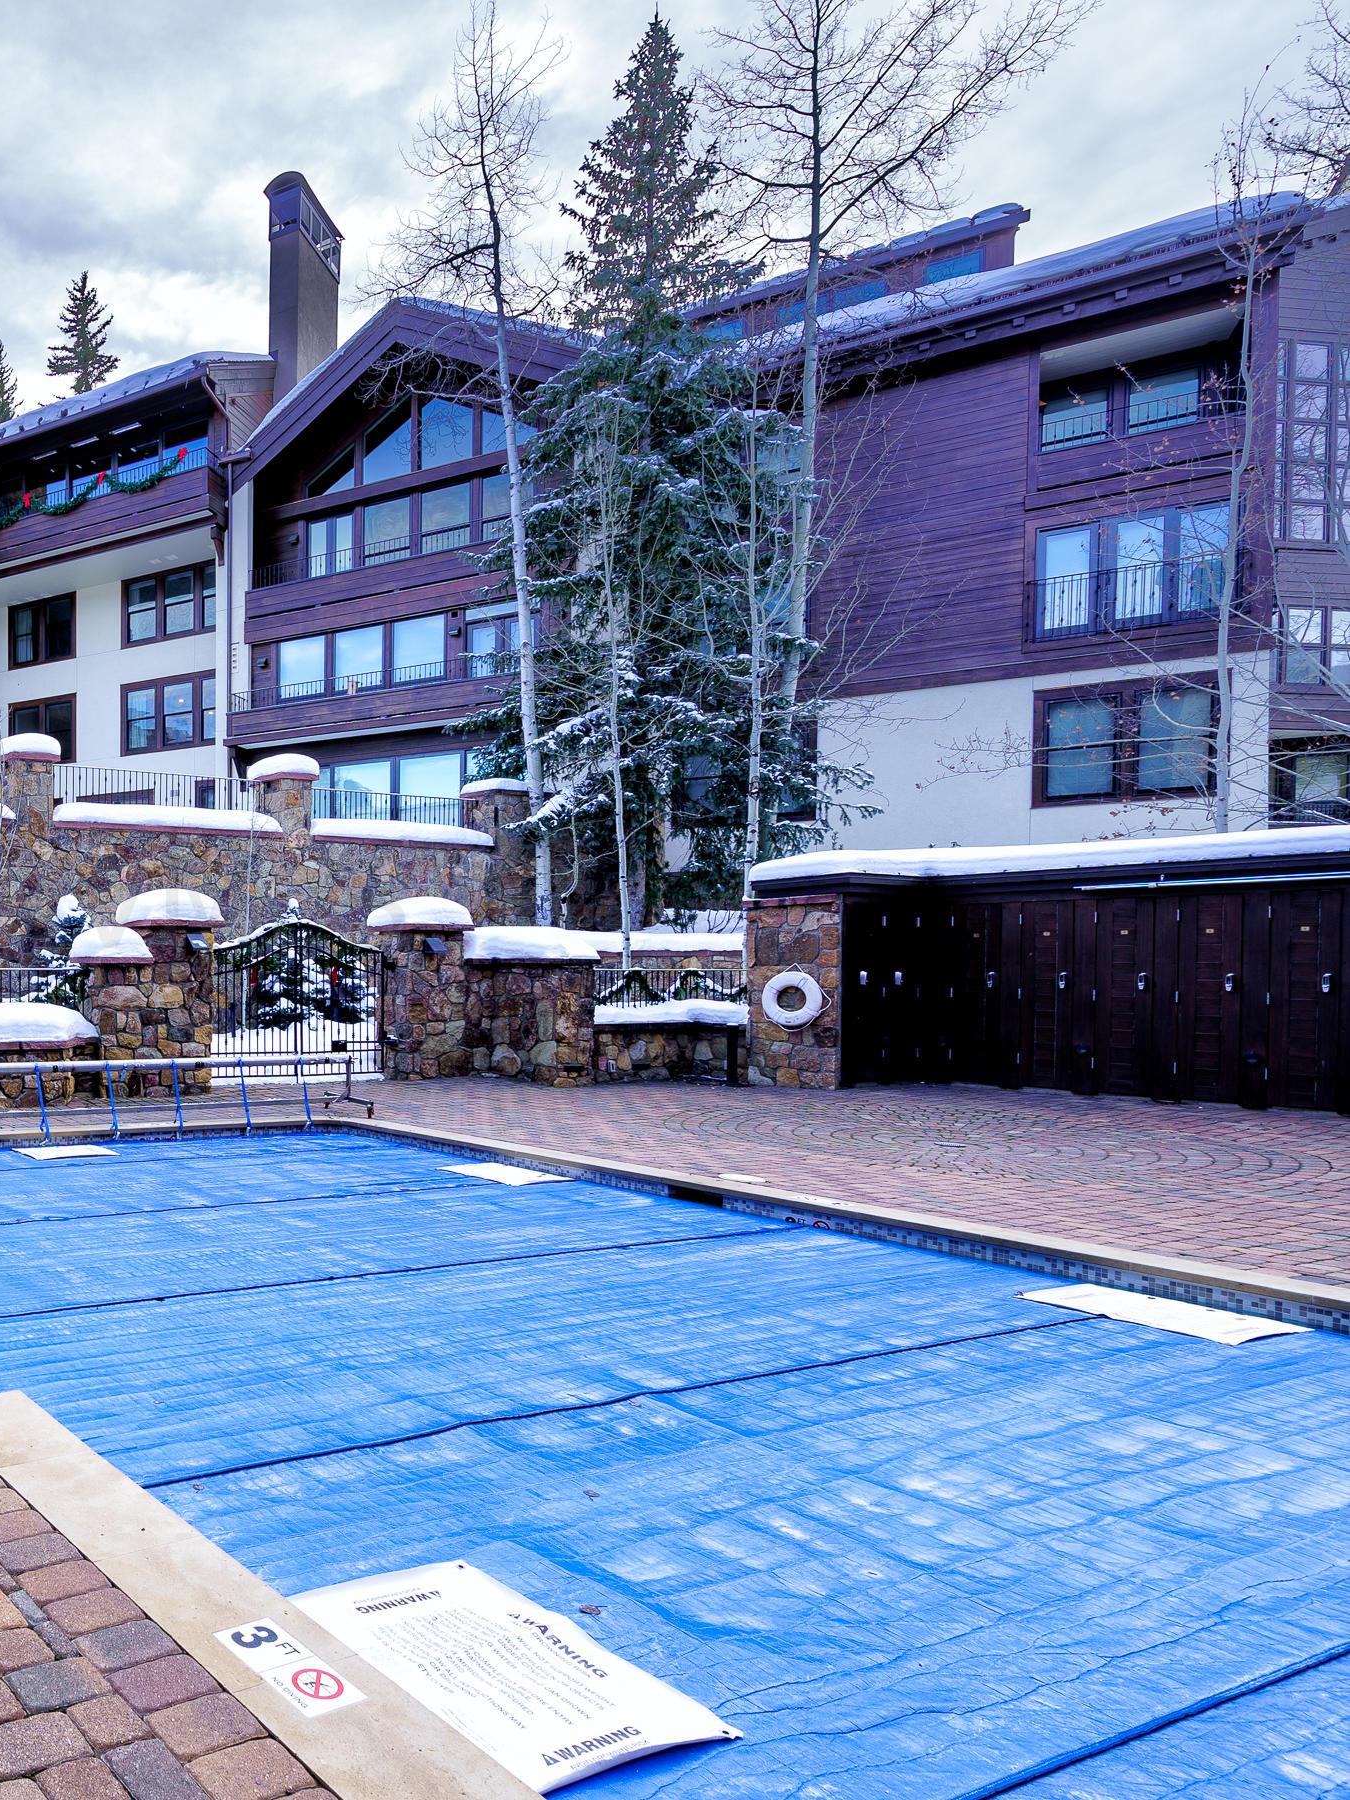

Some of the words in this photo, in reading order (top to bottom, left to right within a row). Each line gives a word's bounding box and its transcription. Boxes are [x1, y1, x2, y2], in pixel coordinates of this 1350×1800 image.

[355, 1592, 432, 1614] WARNING
[231, 1626, 278, 1648] 3
[275, 1642, 300, 1655] FT
[522, 1617, 609, 1678] WARNING
[271, 1676, 284, 1686] NO
[283, 1686, 308, 1709] DIVING
[553, 1725, 643, 1761] WARNING
